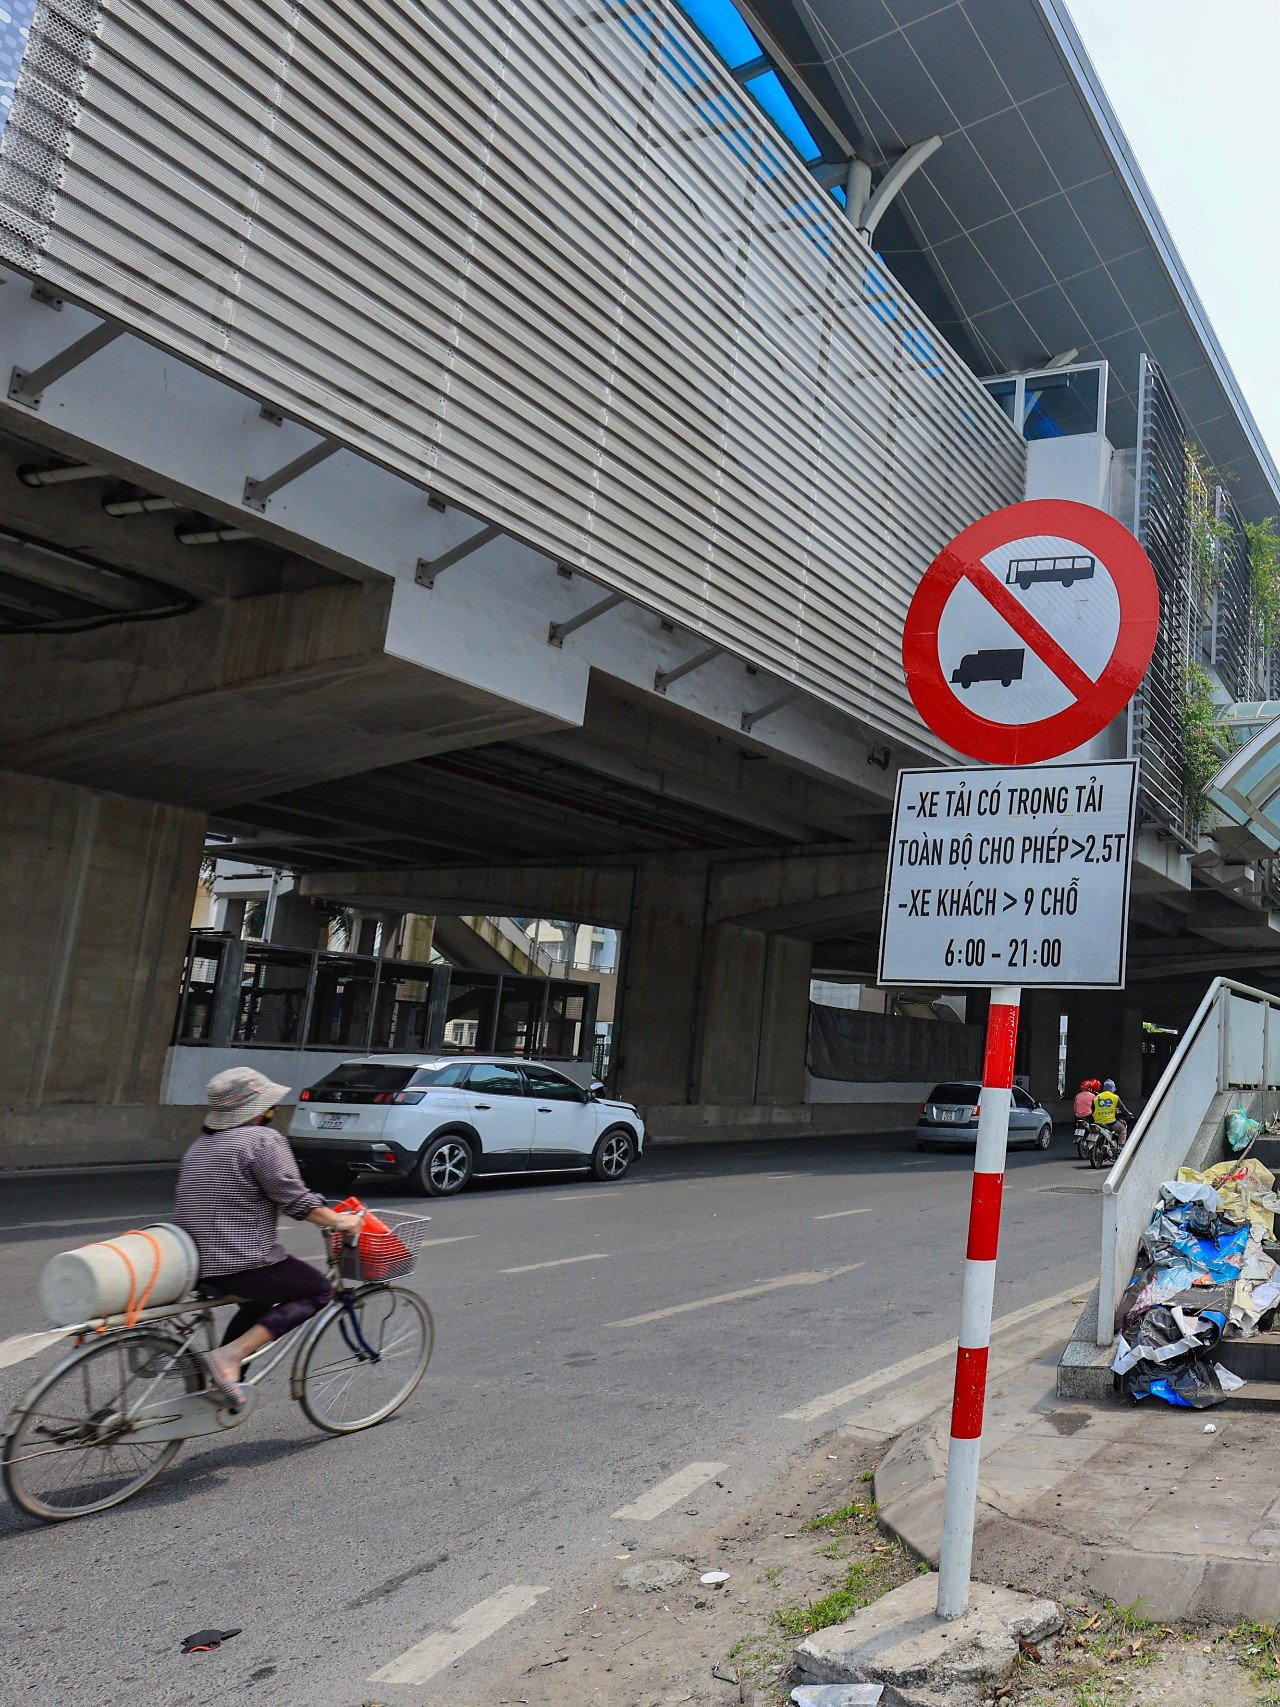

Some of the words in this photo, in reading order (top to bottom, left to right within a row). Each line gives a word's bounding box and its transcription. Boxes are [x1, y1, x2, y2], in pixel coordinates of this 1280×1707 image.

[907, 790, 939, 817] -XE
[946, 782, 971, 817] TẢI
[977, 782, 1001, 816] CÓ
[1008, 786, 1068, 819] TRỌNG
[1075, 776, 1103, 812] TẢI
[899, 832, 943, 866] TOÀN
[950, 833, 972, 870] BỘ
[979, 836, 1014, 865] CHO
[899, 889, 931, 916] -XE
[937, 881, 996, 916] KHÁCH
[1002, 891, 1017, 912] >
[1024, 888, 1034, 916] 9
[1040, 877, 1079, 915] CHỖ
[945, 939, 985, 966] 6:00
[1008, 939, 1061, 967] 21:00
[1098, 1096, 1113, 1107] be
